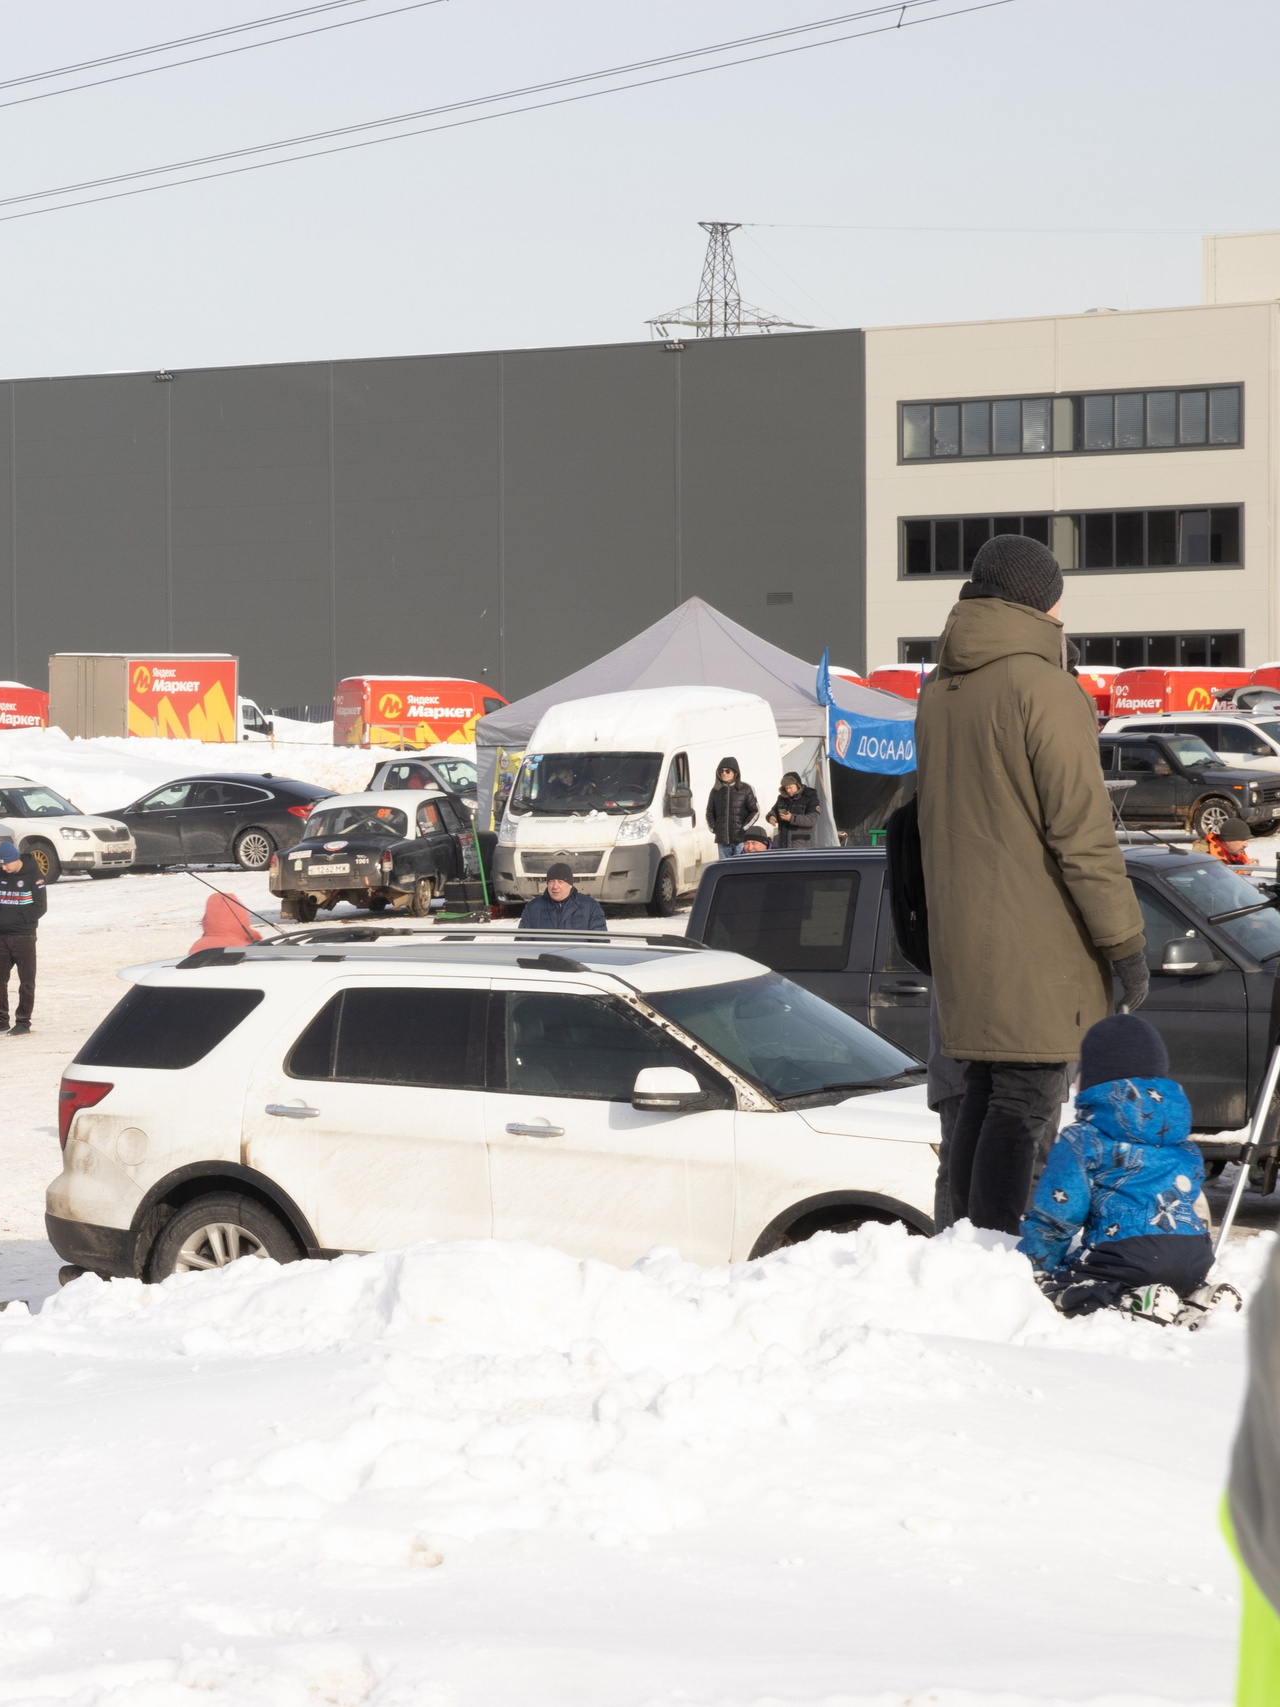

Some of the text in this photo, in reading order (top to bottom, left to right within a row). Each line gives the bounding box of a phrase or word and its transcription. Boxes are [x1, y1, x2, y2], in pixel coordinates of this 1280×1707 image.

[152, 668, 176, 678] Яндекс
[152, 679, 200, 694] Маркет
[407, 695, 439, 705] Яндекс
[1116, 698, 1162, 711] Маркет
[407, 706, 473, 720] Маркет
[857, 736, 913, 760] ДОСААФ
[377, 808, 392, 819] 87
